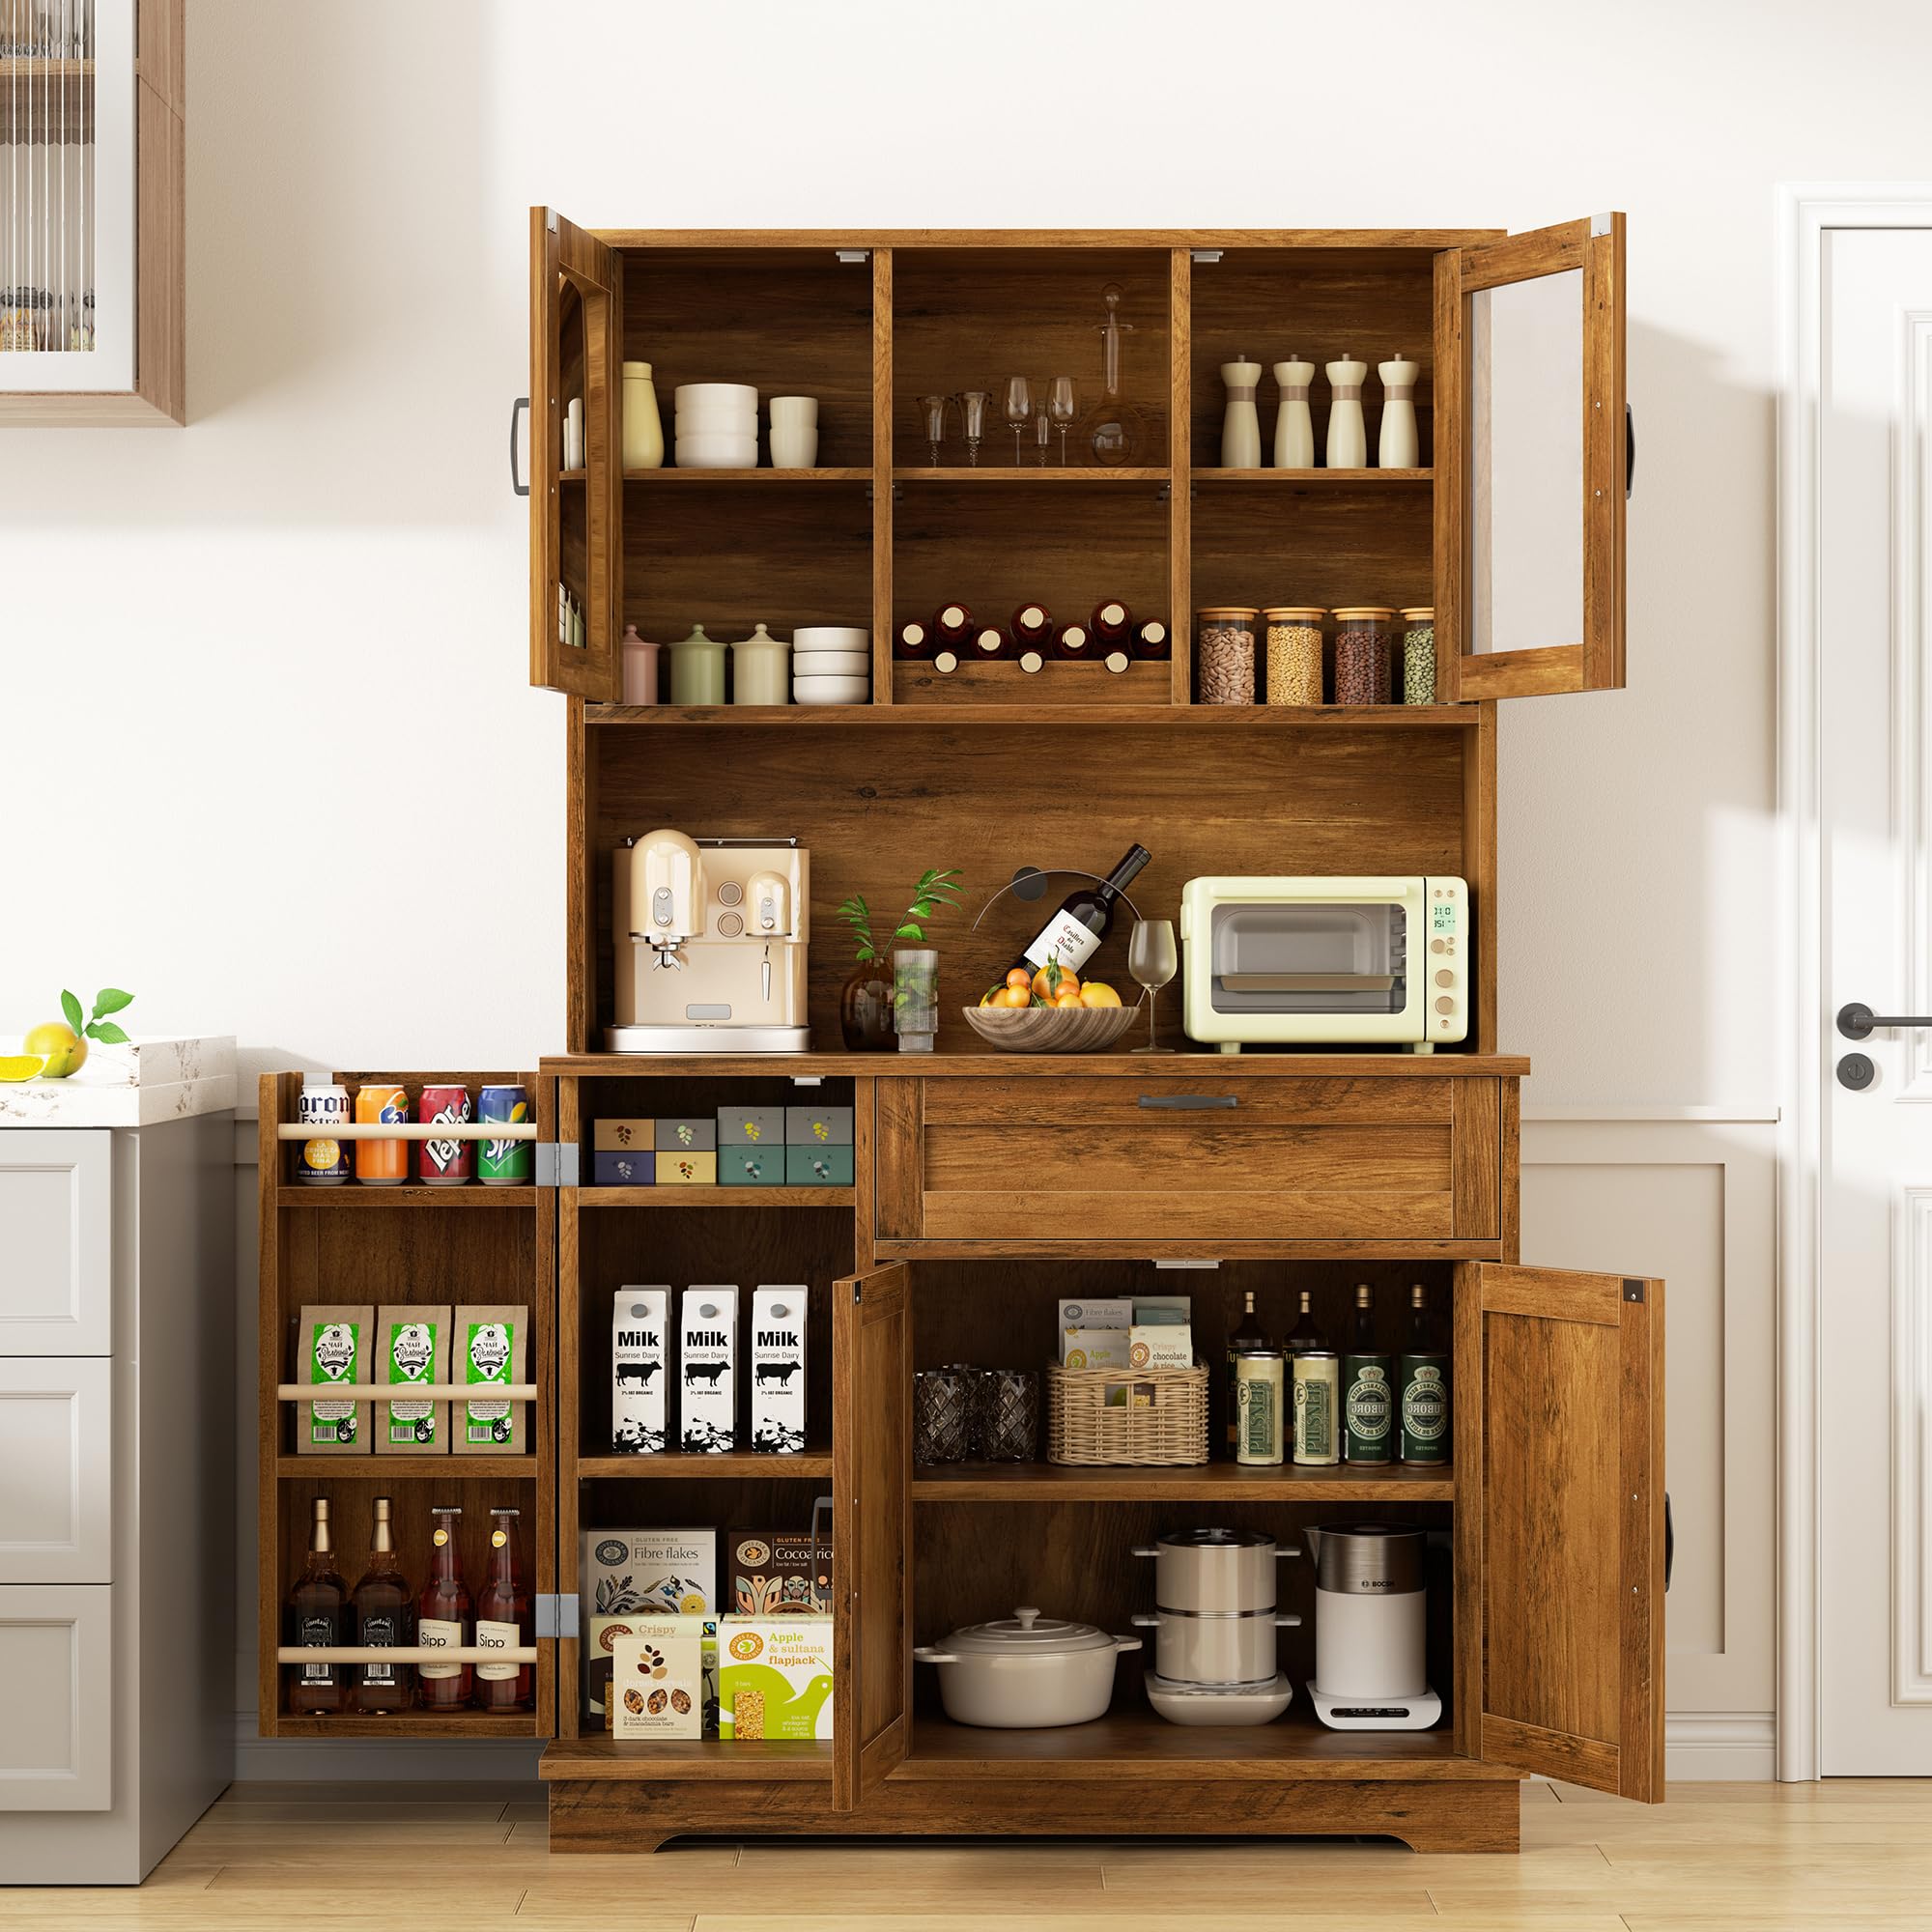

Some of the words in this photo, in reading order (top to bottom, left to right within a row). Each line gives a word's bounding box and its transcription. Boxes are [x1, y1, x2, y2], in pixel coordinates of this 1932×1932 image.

[1064, 924, 1085, 946] Casillero
[1057, 936, 1074, 953] Diablo
[299, 1095, 350, 1113] oron
[618, 1331, 659, 1347] Milk
[687, 1331, 727, 1347] Milk
[757, 1331, 798, 1347] Milk
[1152, 1343, 1176, 1352] Crispy
[1250, 1383, 1265, 1453] PILSNER
[1306, 1383, 1322, 1453] PILSNER
[635, 1547, 663, 1559] Fibre
[666, 1547, 698, 1559] flakes
[776, 1548, 811, 1559] Cocoa
[639, 1625, 676, 1634] Crispy
[421, 1633, 446, 1647] Sipp
[479, 1634, 505, 1647] Sipp
[769, 1633, 804, 1643] Apple
[769, 1656, 816, 1666] flapjack
